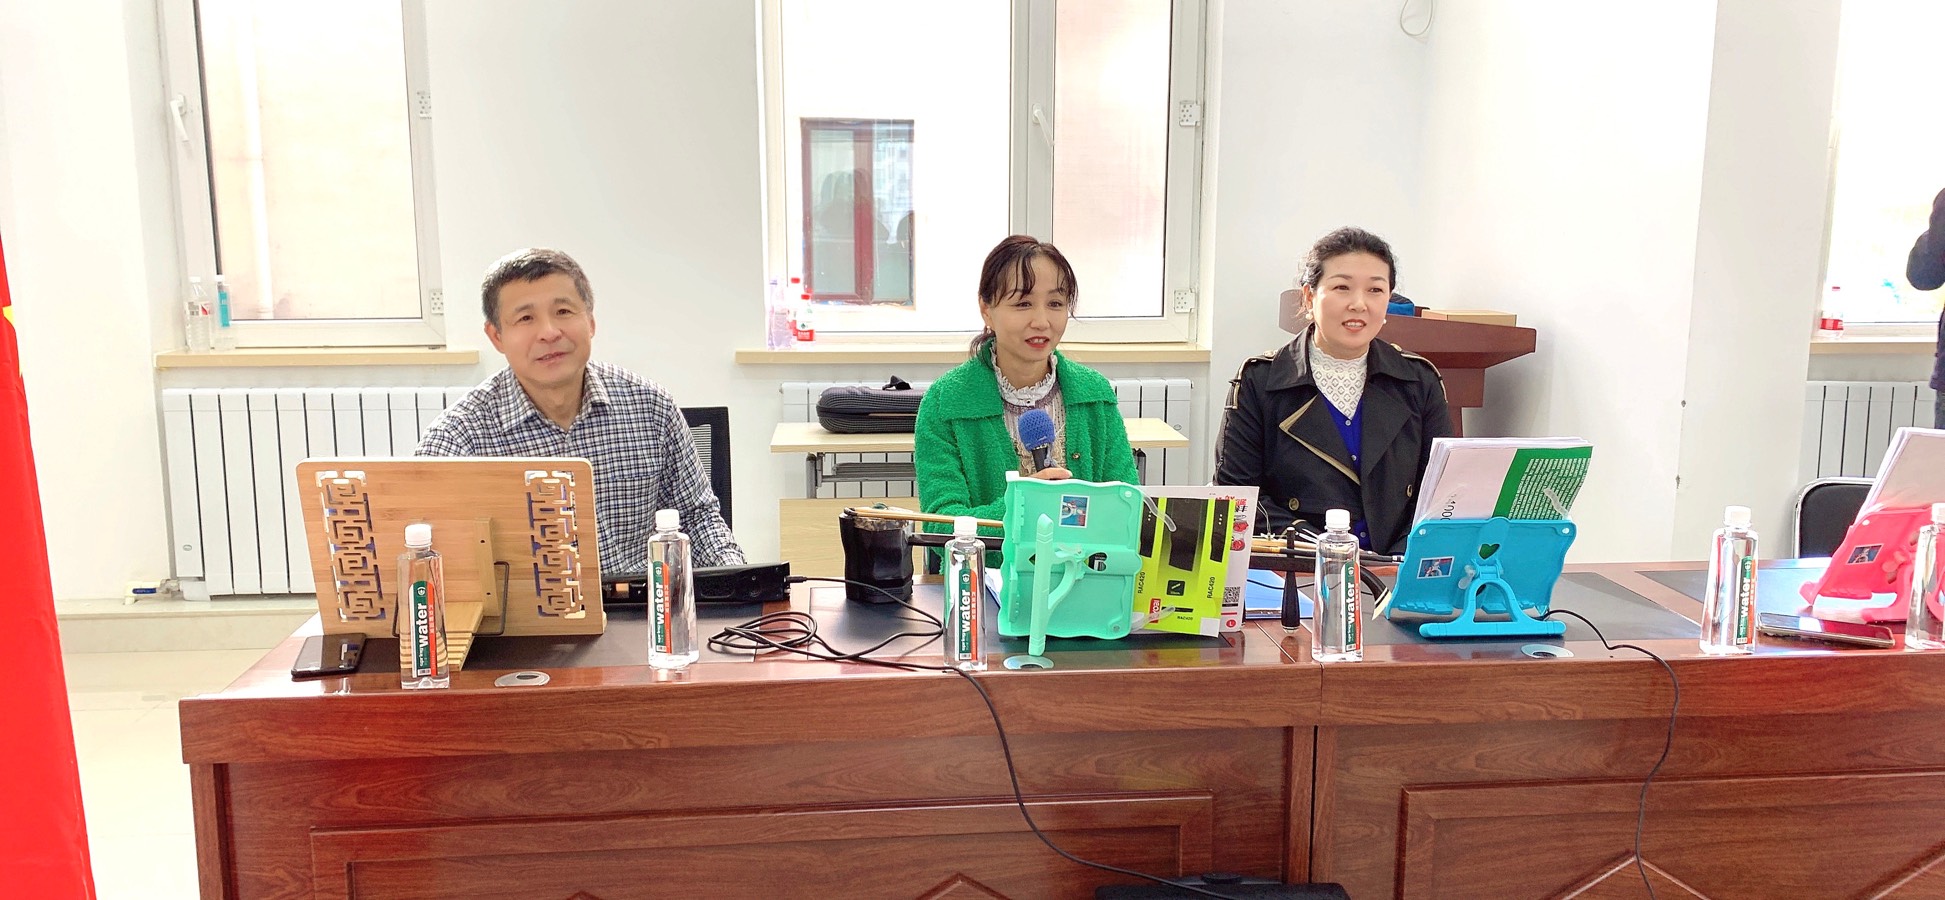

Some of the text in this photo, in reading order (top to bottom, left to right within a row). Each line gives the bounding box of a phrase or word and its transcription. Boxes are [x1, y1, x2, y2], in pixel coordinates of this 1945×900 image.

[654, 582, 665, 625] water
[1207, 576, 1216, 599] RAC420
[1345, 582, 1355, 624] water
[1740, 577, 1751, 617] water
[416, 603, 429, 648] water
[960, 589, 971, 633] water
